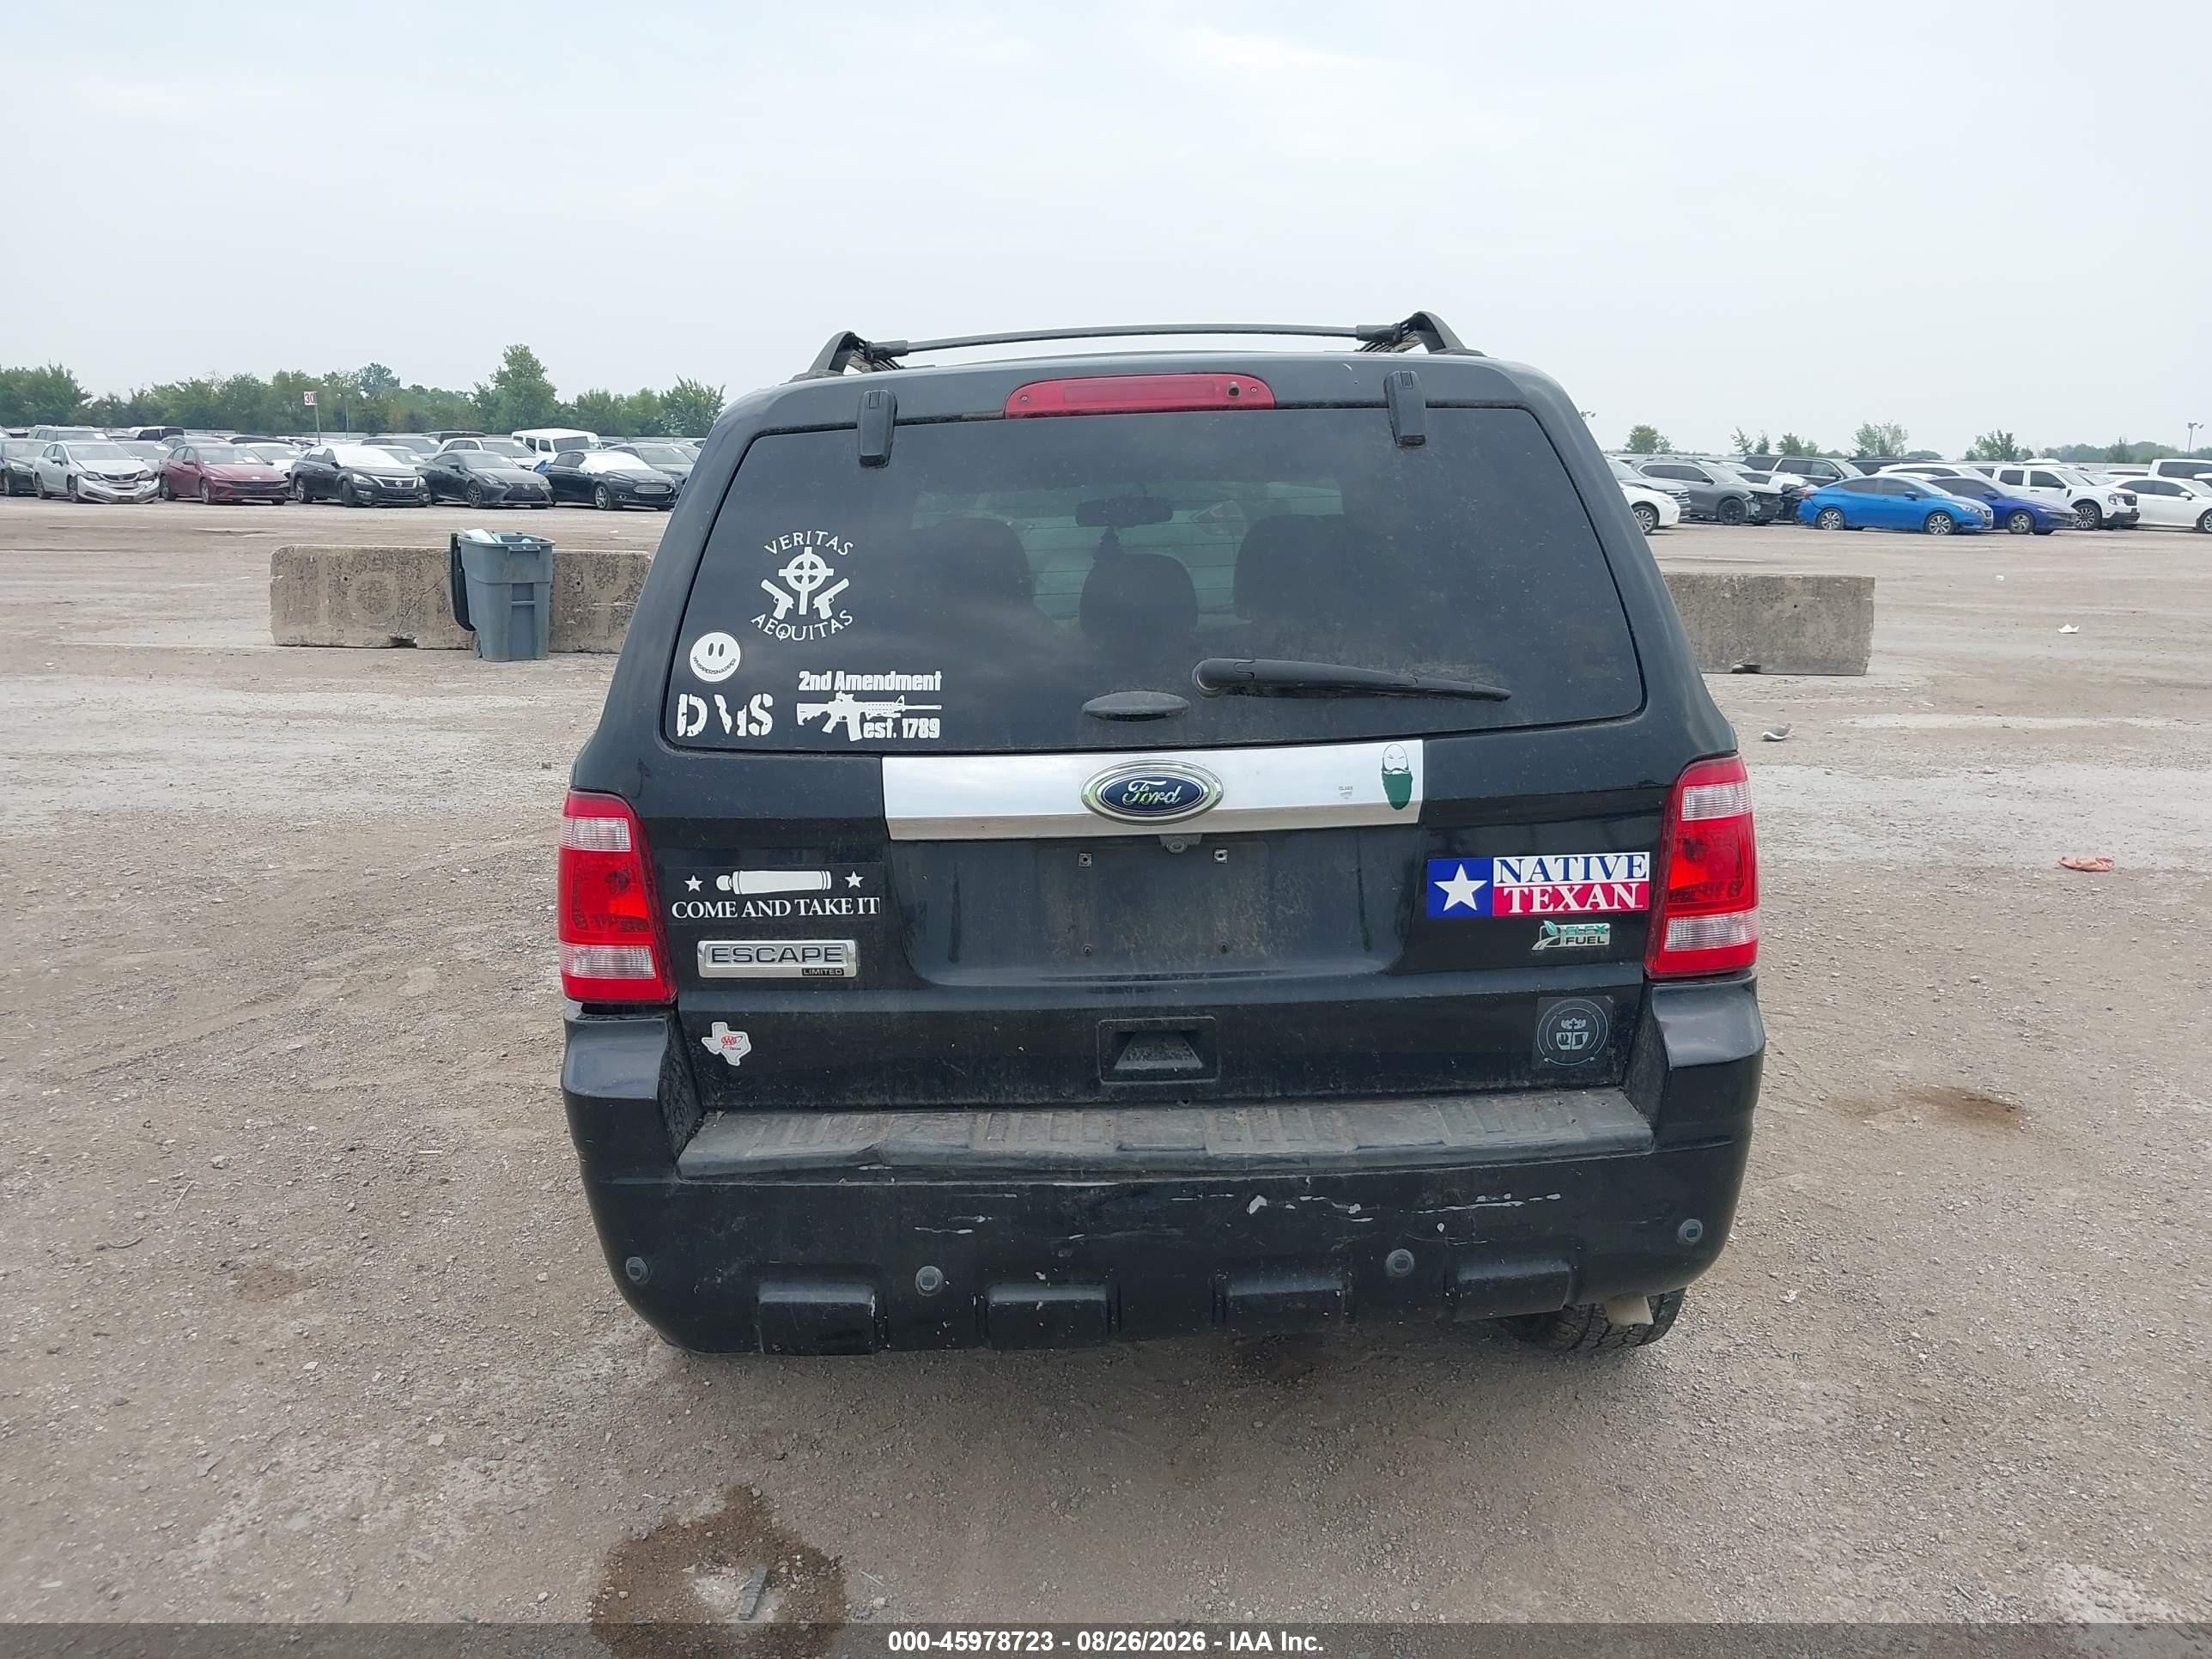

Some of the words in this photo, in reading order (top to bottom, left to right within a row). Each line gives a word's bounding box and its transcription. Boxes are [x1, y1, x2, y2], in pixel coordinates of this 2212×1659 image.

[305, 392, 314, 404] 30
[764, 531, 854, 556] VERITAS
[750, 610, 854, 641] AEQUITAS
[693, 655, 737, 675] WHIPPERSNAPPER
[799, 670, 832, 690] 2nd
[834, 670, 942, 690] Amendment
[863, 718, 897, 738] est.
[902, 718, 940, 738] 1789
[1121, 780, 1182, 805] Ford
[1497, 854, 1647, 884] NATIVE
[672, 901, 738, 919] COME
[742, 900, 792, 918] AND
[794, 898, 854, 916] TAKE
[857, 897, 880, 915] IT
[1504, 883, 1640, 914] TEXAN
[1565, 924, 1608, 936] FLEX
[1565, 935, 1606, 945] FUEL
[711, 946, 843, 963] ESCAPE
